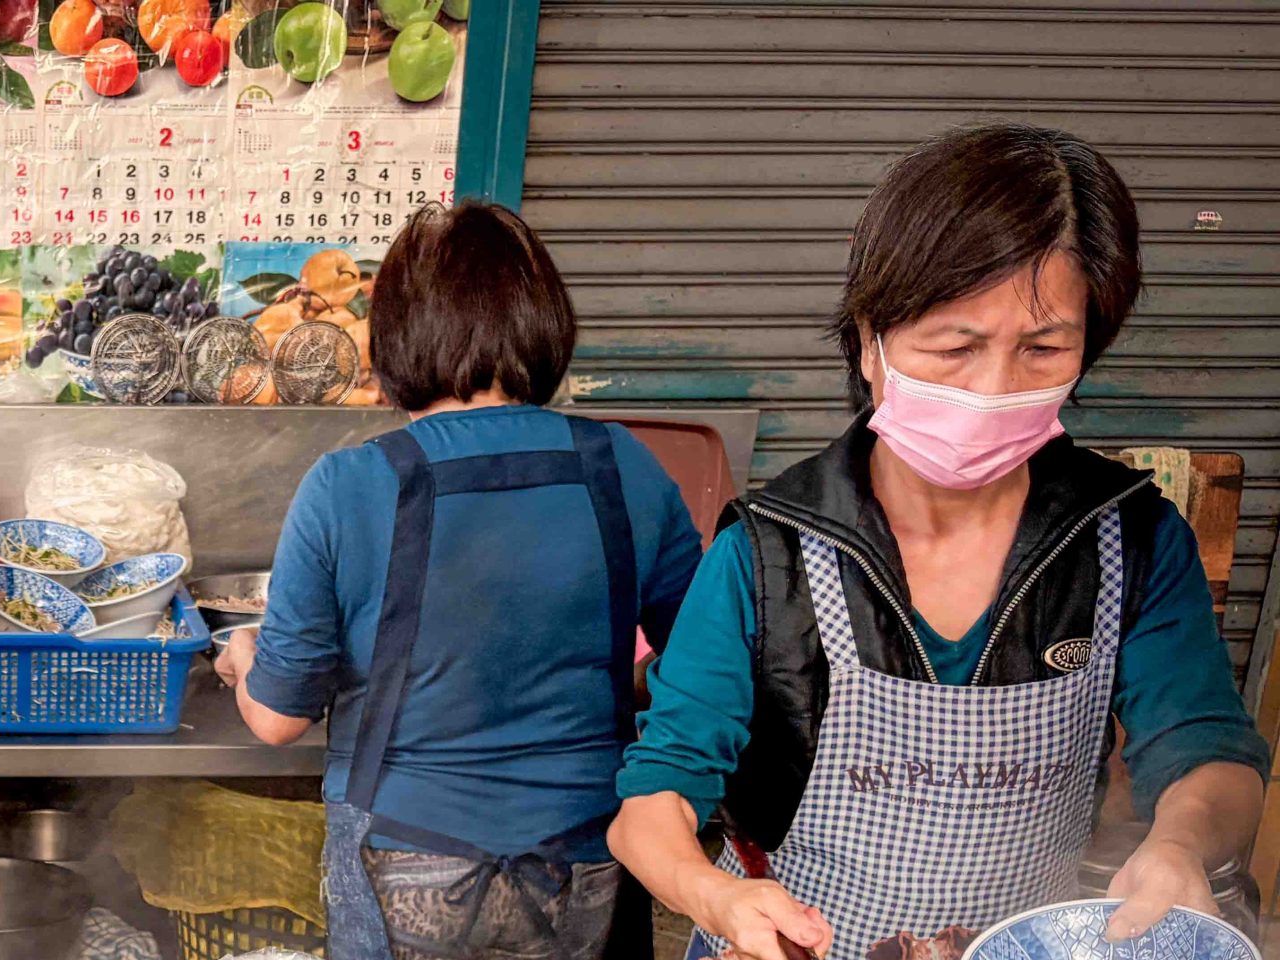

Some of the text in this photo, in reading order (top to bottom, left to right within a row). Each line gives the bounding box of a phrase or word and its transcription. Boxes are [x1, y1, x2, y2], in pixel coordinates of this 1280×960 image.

[160, 128, 173, 147] 2
[347, 131, 361, 150] 3
[16, 164, 27, 176] 2
[126, 164, 137, 178] 2
[159, 165, 170, 178] 3
[282, 168, 455, 182] 1 2 3 4 5 6
[16, 186, 27, 197] 9
[60, 187, 69, 200] 7
[92, 187, 103, 200] 8
[125, 187, 136, 201] 9
[153, 188, 174, 201] 10
[187, 188, 205, 201] 11
[248, 191, 257, 204] 7
[280, 191, 291, 204] 8
[313, 191, 323, 204] 9
[341, 191, 360, 204] 10
[373, 191, 392, 204] 11
[406, 191, 426, 204] 12
[54, 210, 206, 223] 14 15 16 17 18
[243, 213, 262, 226] 14
[275, 213, 295, 227] 15
[307, 213, 328, 227] 16
[340, 213, 360, 227] 17
[373, 213, 392, 227] 18
[11, 231, 32, 244] 23
[52, 232, 73, 245] 21
[119, 233, 139, 245] 23
[151, 233, 172, 245] 24
[184, 233, 205, 245] 25
[846, 764, 894, 793] MY
